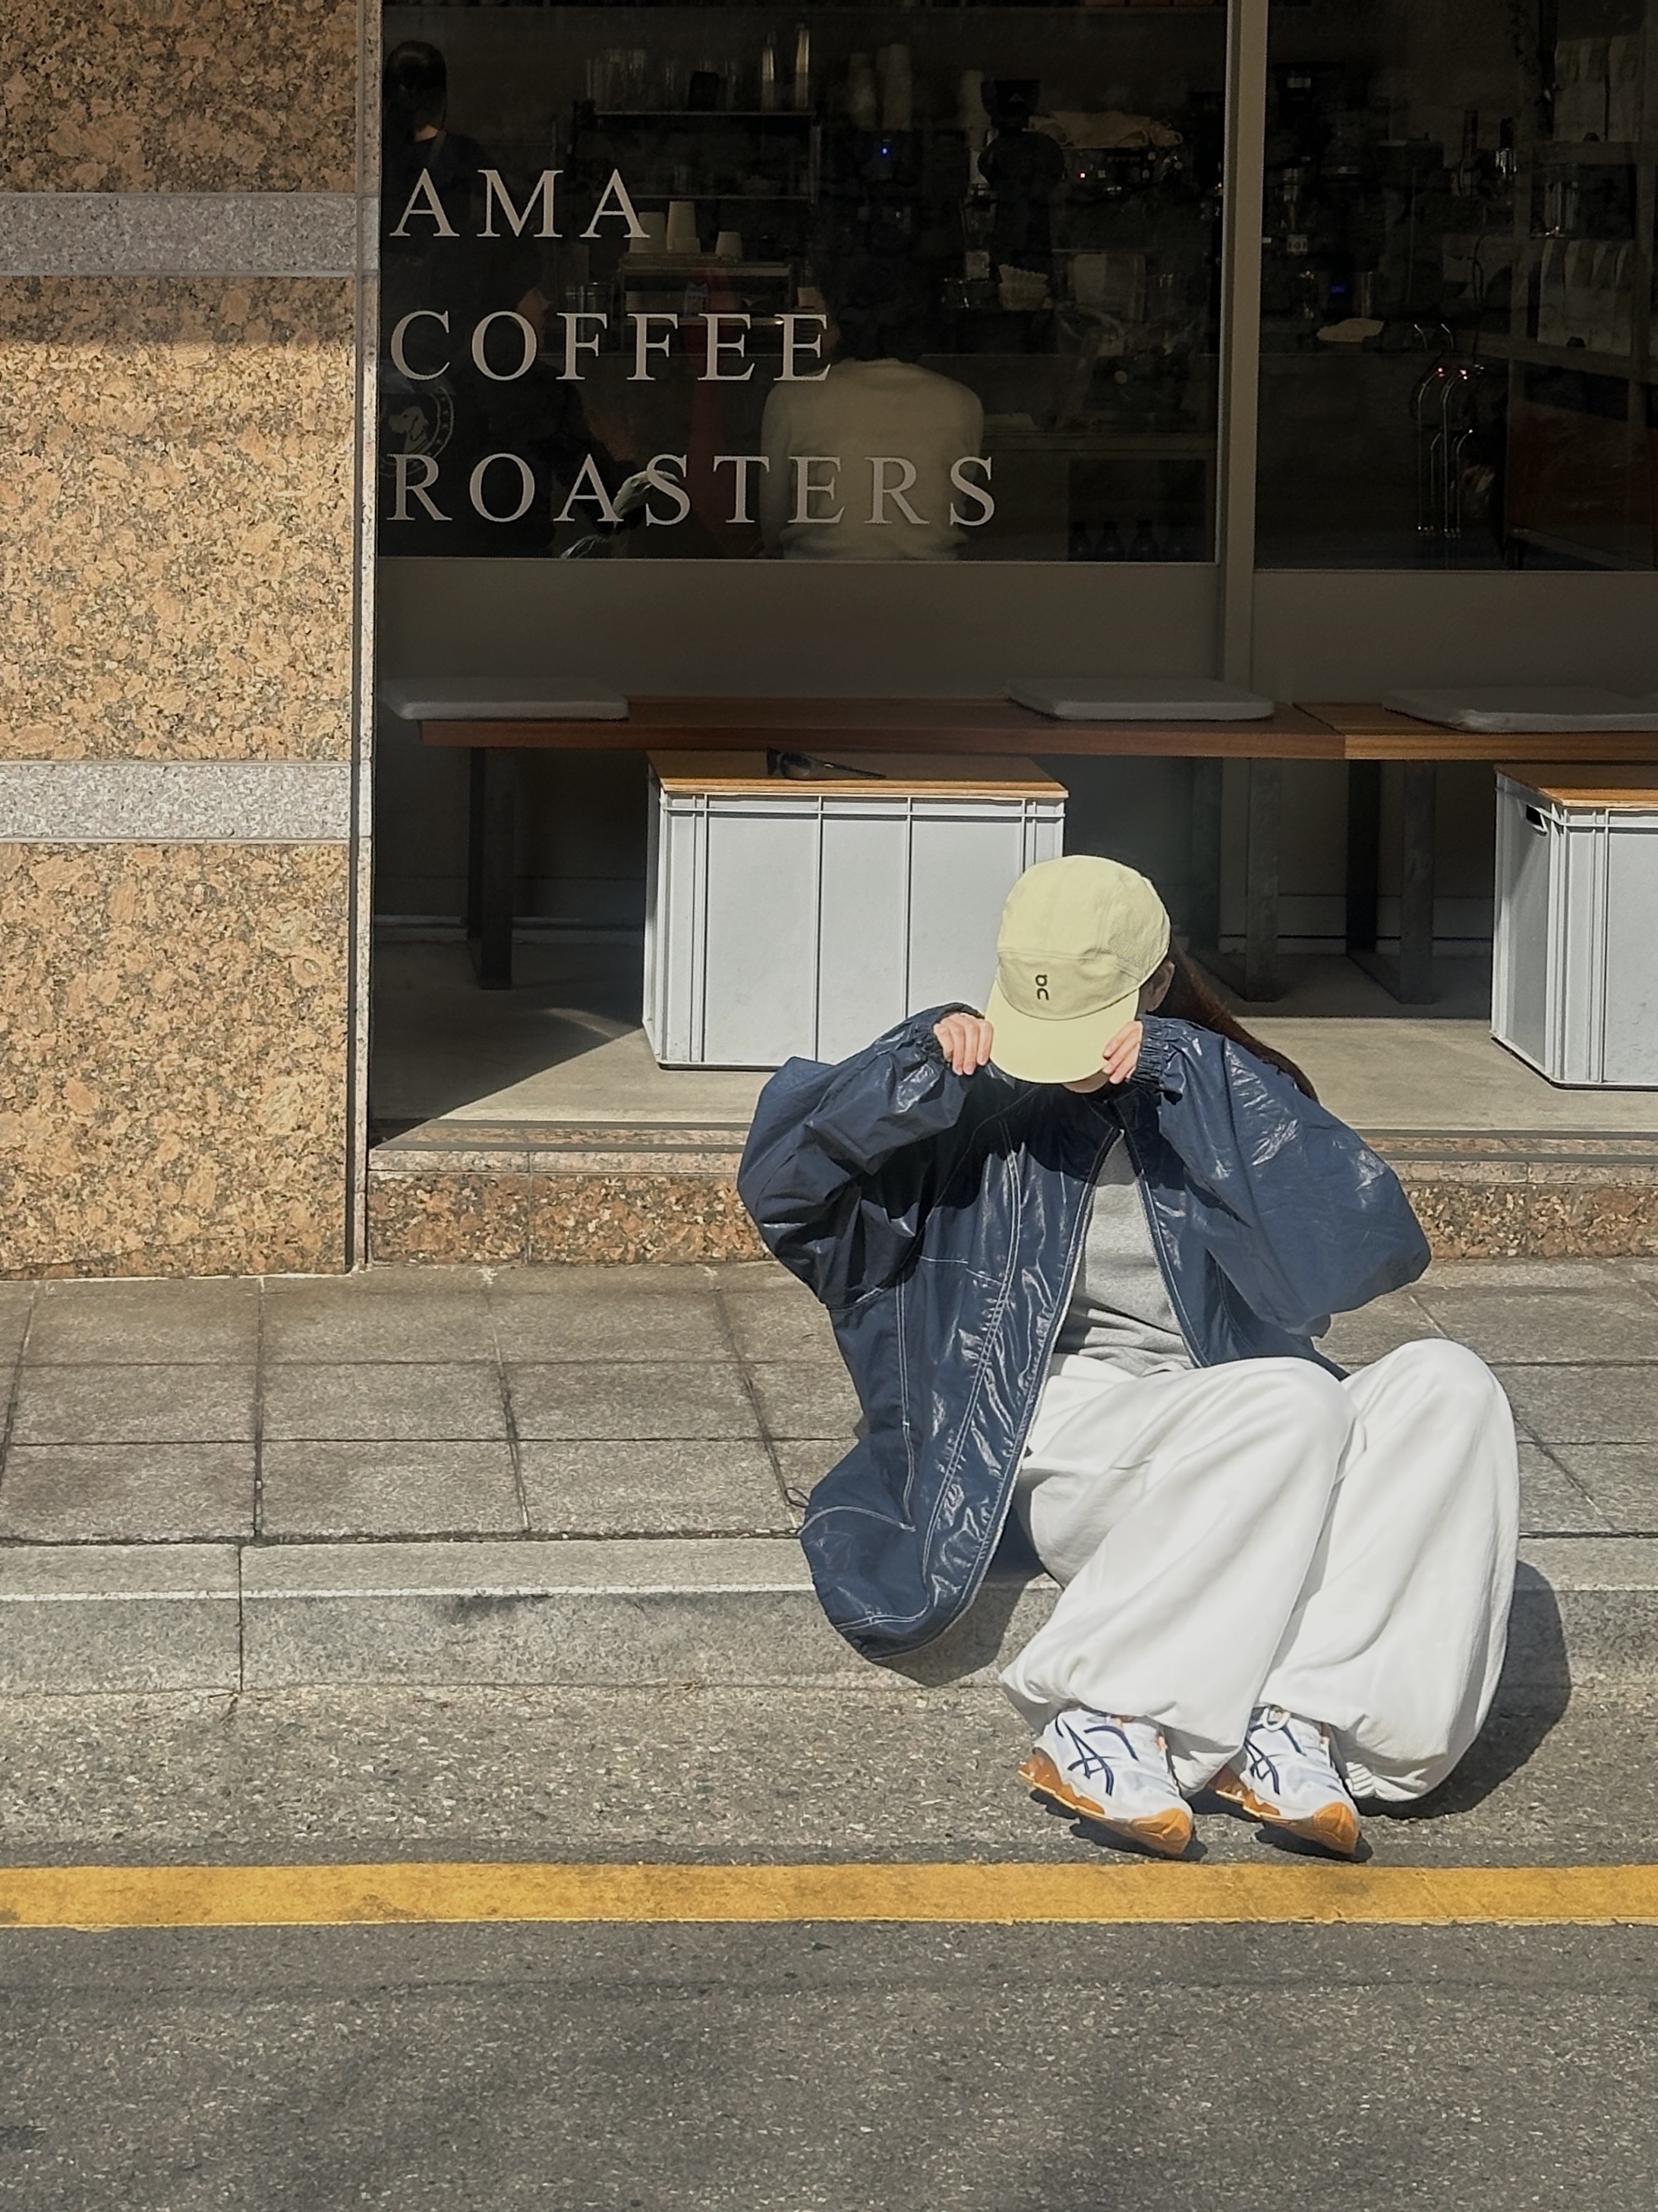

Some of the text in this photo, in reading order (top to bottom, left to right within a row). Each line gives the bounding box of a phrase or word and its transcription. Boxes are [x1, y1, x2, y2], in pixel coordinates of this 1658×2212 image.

[389, 168, 651, 239] AMA
[389, 310, 832, 383] COFFEE
[386, 453, 996, 527] ROASTERS
